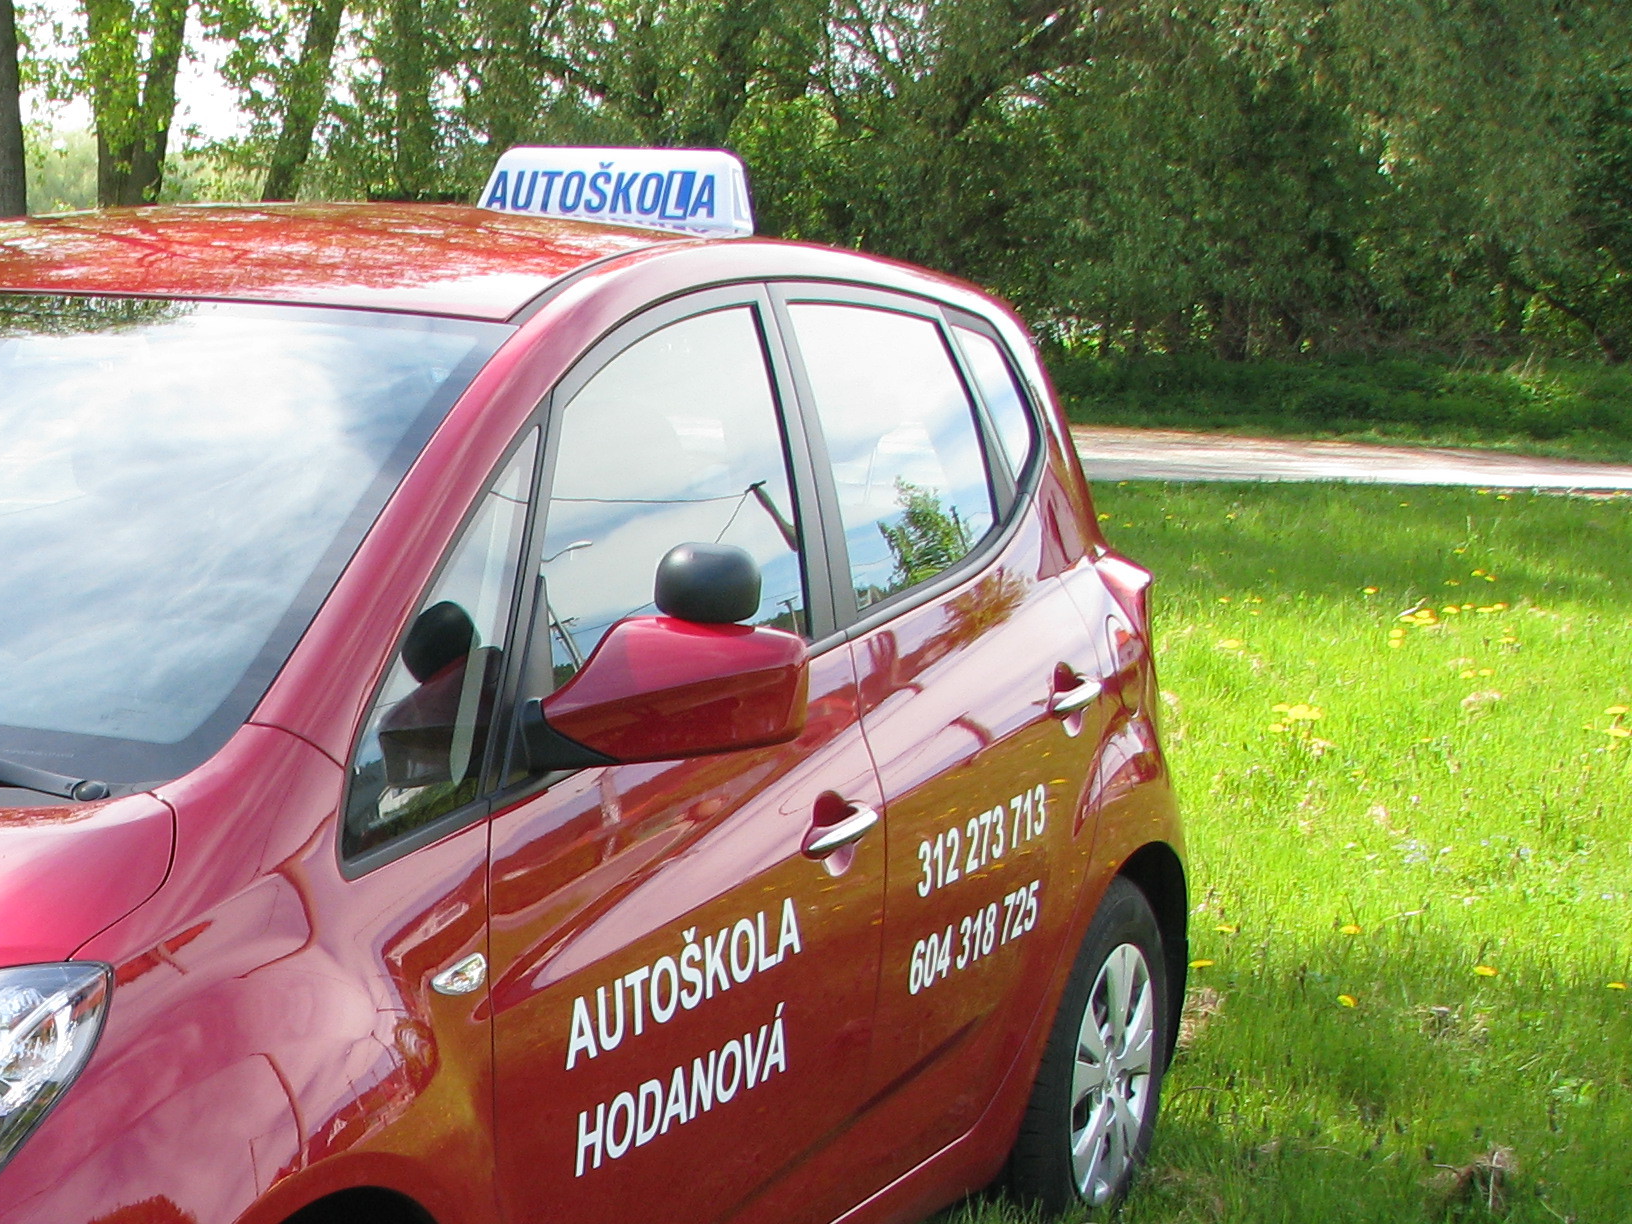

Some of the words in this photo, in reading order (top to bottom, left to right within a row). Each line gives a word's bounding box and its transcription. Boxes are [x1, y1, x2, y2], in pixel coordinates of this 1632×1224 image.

[486, 161, 715, 220] AUTOŠKOLA
[918, 827, 961, 898] 312
[966, 805, 1005, 874] 273
[1010, 783, 1048, 849] 713
[565, 897, 801, 1071] AUTOŠKOLA
[909, 924, 953, 995] 604
[956, 902, 998, 970] 318
[1000, 880, 1040, 946] 725
[575, 1002, 786, 1178] HODANOVÁ
